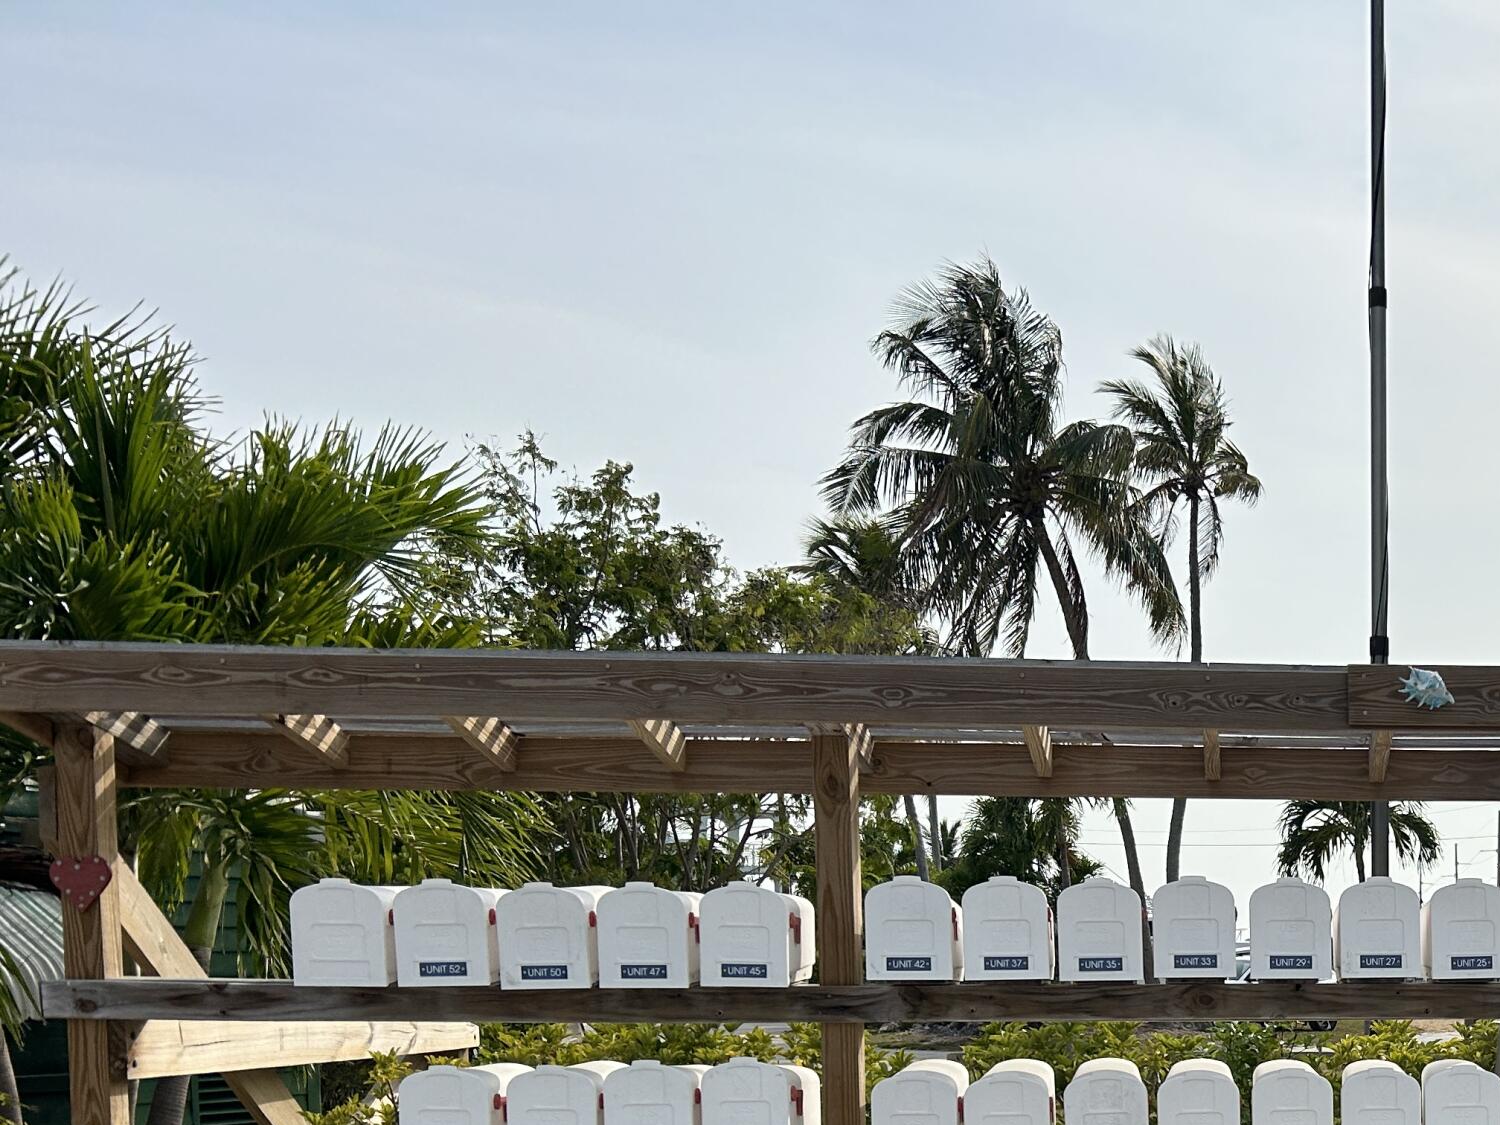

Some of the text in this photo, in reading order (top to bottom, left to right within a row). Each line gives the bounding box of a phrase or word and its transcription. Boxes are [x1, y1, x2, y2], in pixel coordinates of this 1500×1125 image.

[892, 960, 925, 968] UNIT 42
[990, 959, 1022, 968] UNIT 37
[1085, 960, 1117, 969] UNIT 35
[1180, 957, 1211, 966] UNIT 33
[1275, 958, 1307, 967] UNIT 29
[1365, 957, 1396, 966] UNIT 27
[1457, 958, 1487, 967] UNIT 25
[426, 964, 461, 974] UNIT 52
[527, 968, 562, 977] UNIT 50
[627, 967, 660, 976] UNIT 47
[727, 966, 761, 976] UNIT 45
